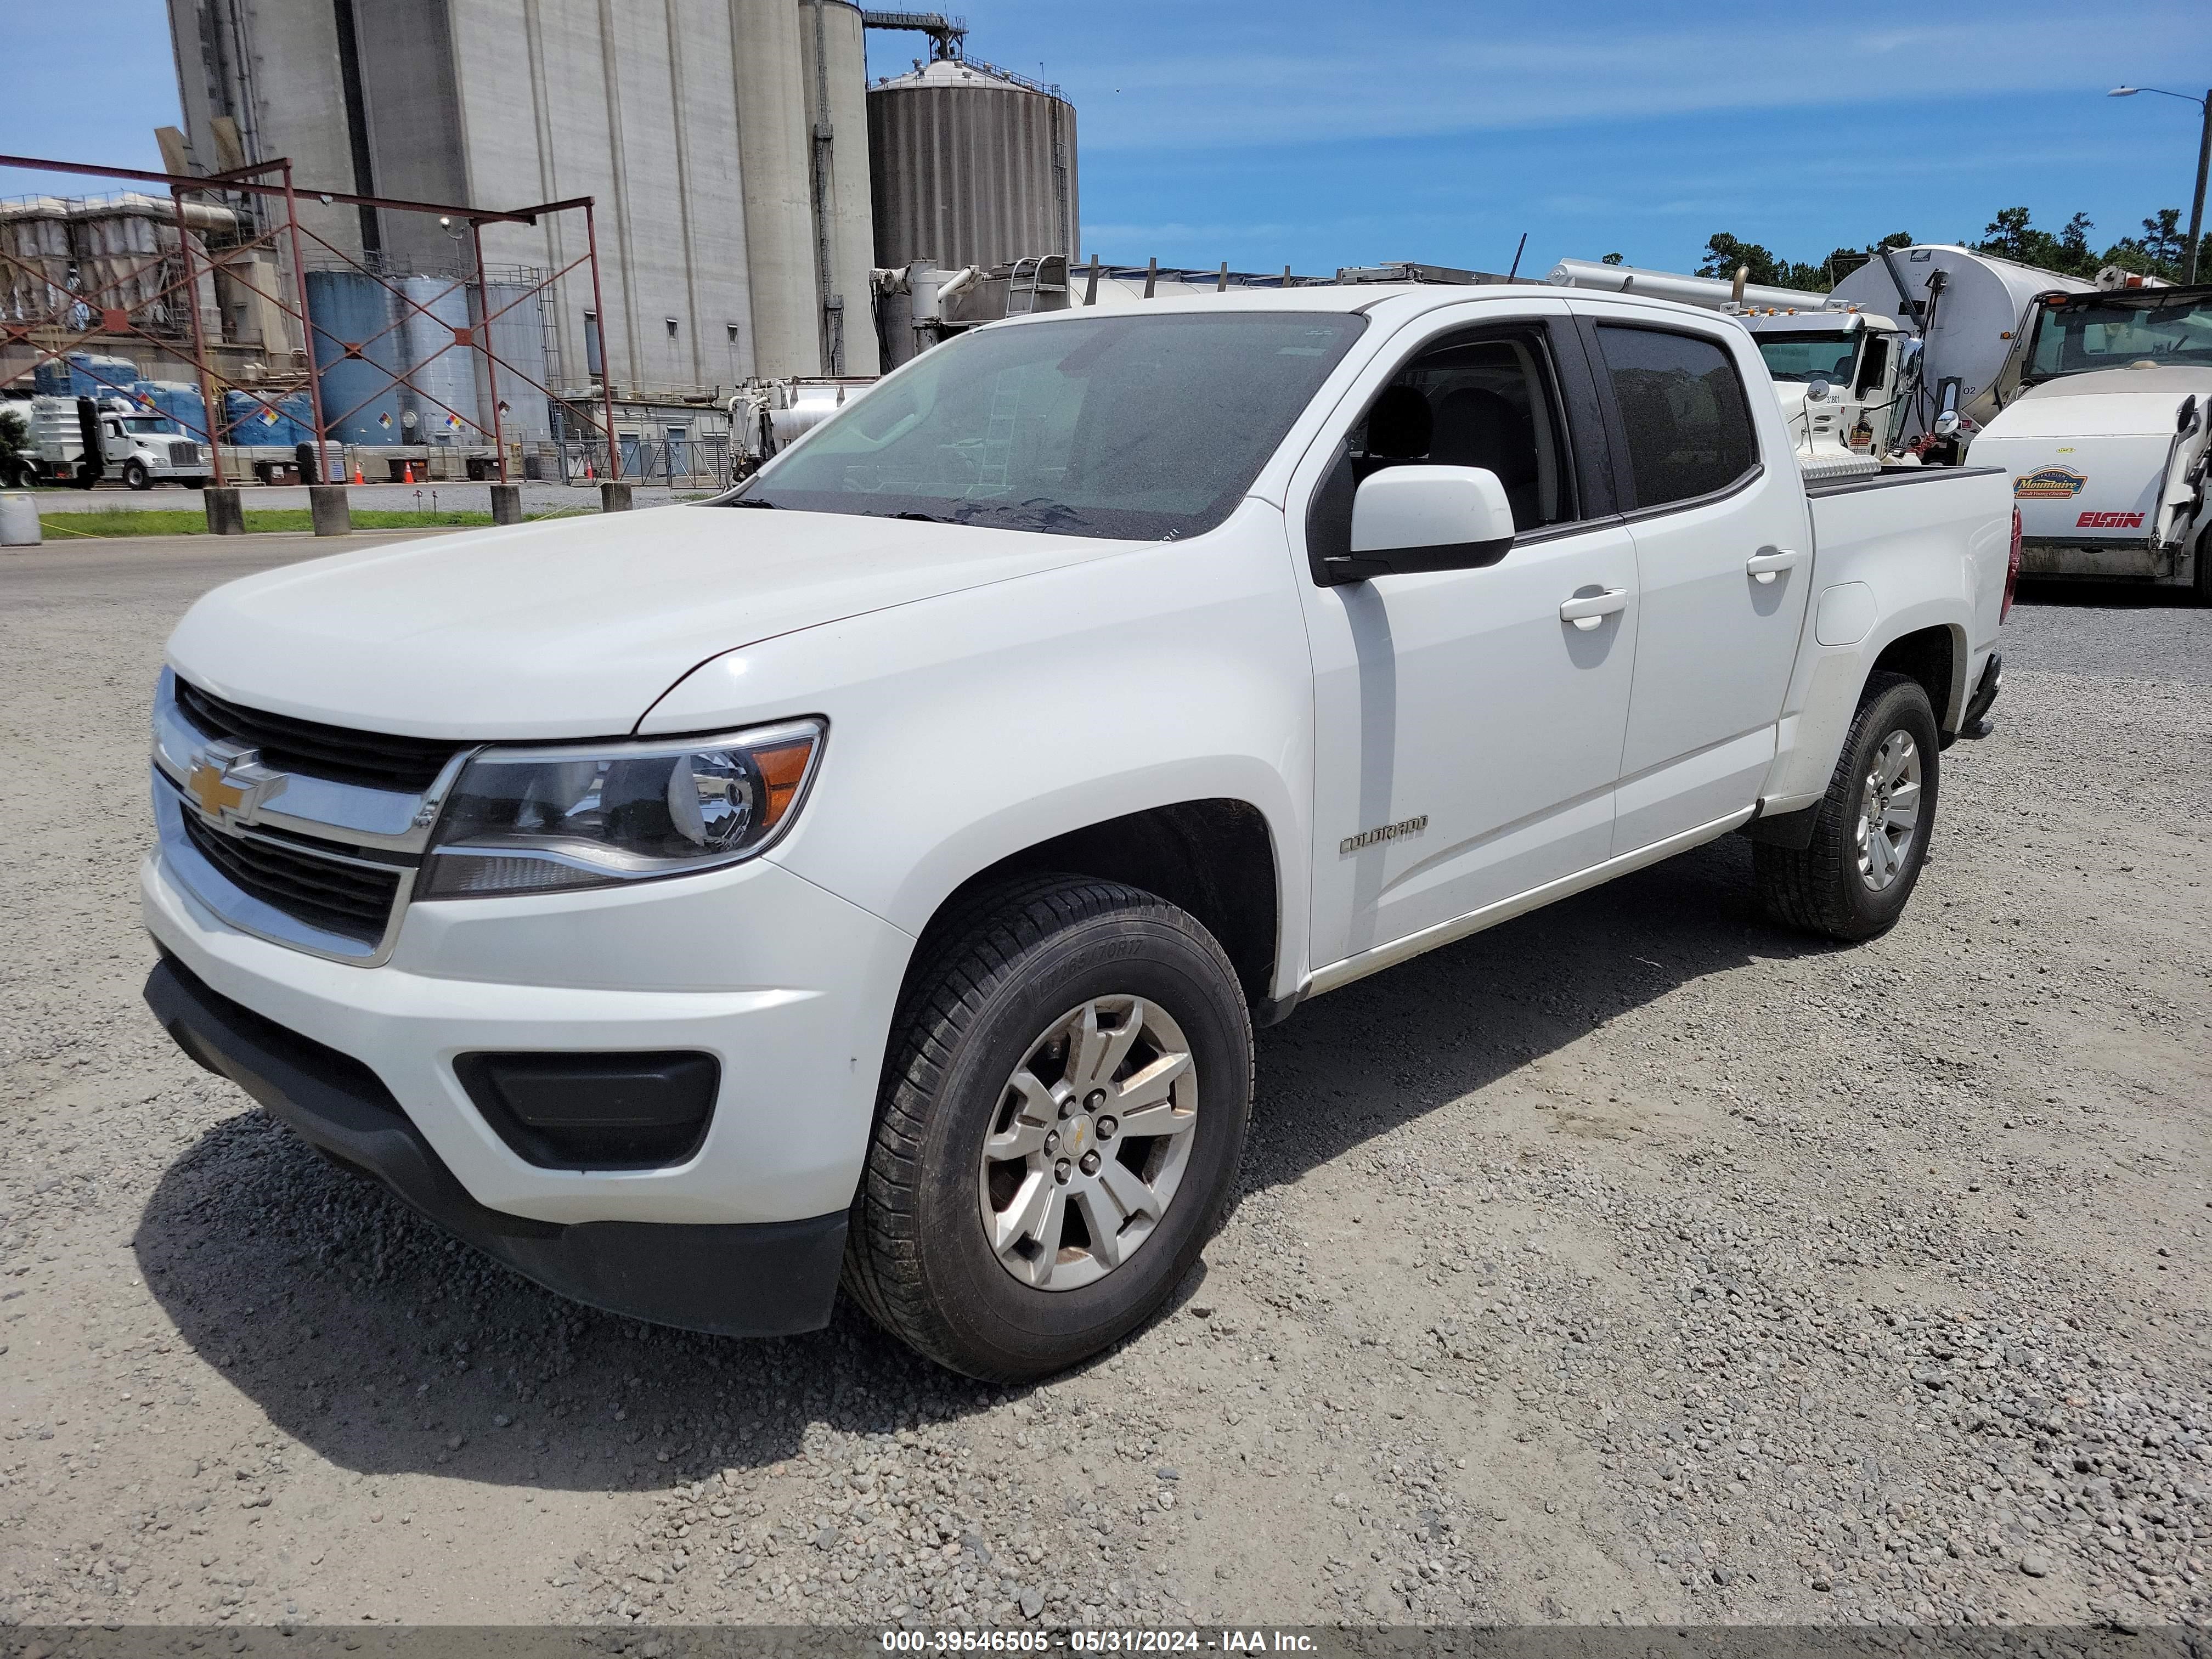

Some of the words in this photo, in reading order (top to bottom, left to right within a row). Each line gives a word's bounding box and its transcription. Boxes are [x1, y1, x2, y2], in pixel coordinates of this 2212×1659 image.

[1827, 395, 1839, 404] 31801
[2018, 479, 2079, 489] Mountaire
[1340, 815, 1429, 854] COLORADO
